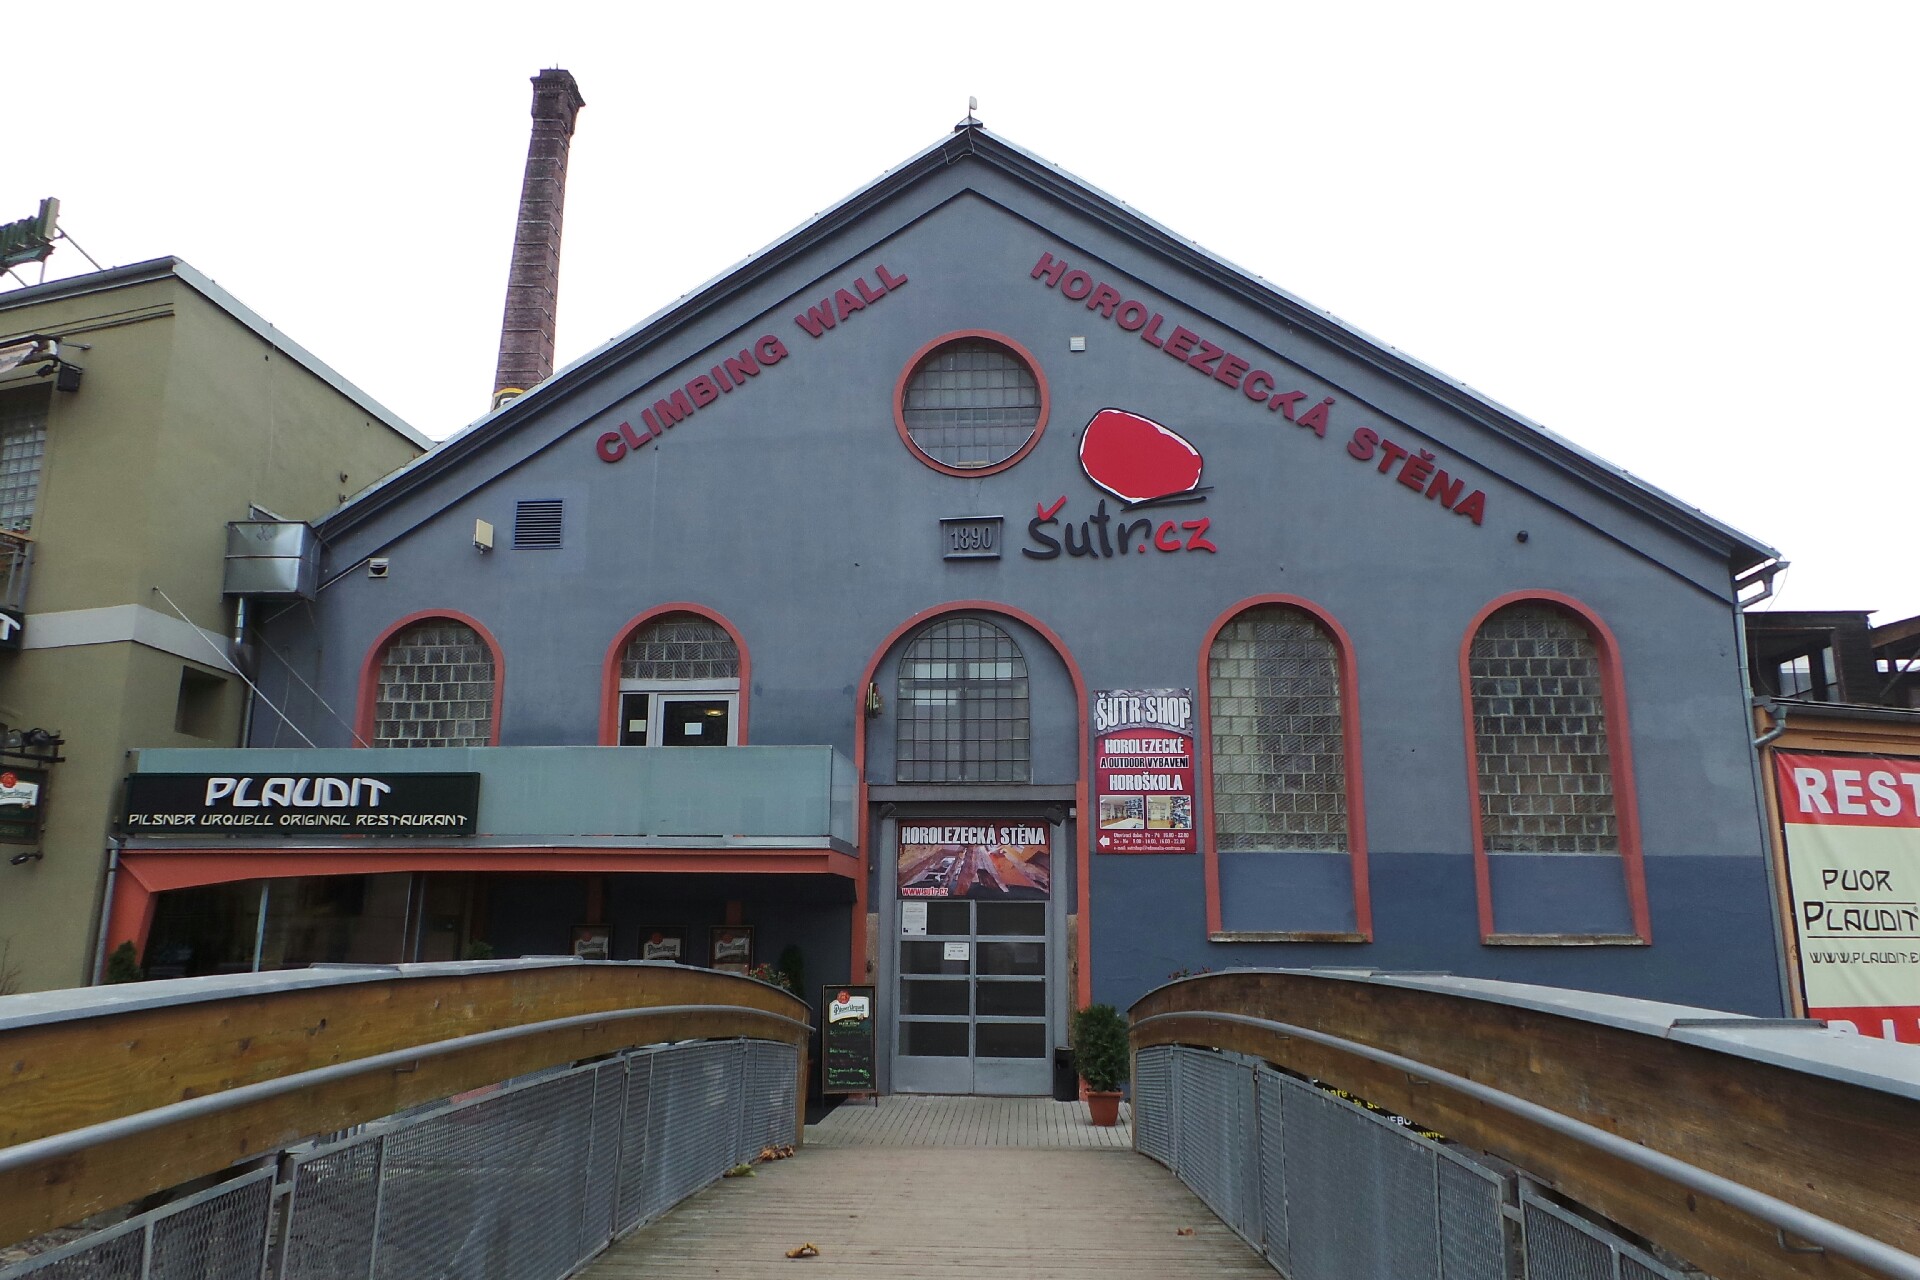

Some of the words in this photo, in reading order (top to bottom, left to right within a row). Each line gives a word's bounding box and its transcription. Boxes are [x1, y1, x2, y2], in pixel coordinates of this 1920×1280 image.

[596, 334, 789, 463] CLIMBING
[794, 264, 909, 338] WALL
[1030, 251, 1336, 438] HOROLEZECKÁ
[1347, 427, 1486, 526] STĚNA
[950, 527, 993, 551] 1890
[1096, 692, 1141, 731] ŠUTR
[1146, 696, 1191, 729] SHOP
[1105, 736, 1185, 754] HOROLEZECKÉ
[1100, 757, 1107, 768] A
[1108, 757, 1145, 768] OUTDOOR
[1147, 755, 1189, 768] VYBAVENÍ
[1109, 772, 1183, 791] HOROŠKOLA
[205, 777, 391, 808] PLAUDIT
[128, 814, 195, 826] PILSNER
[201, 814, 274, 826] URQUELL
[279, 814, 351, 826] ORIGINAL
[355, 814, 468, 827] RESTAURANT
[902, 824, 996, 845] HOROLEZECKÁ
[1000, 824, 1046, 845] STĚNA
[1809, 952, 1920, 964] WWW.PLAUDIT.E
